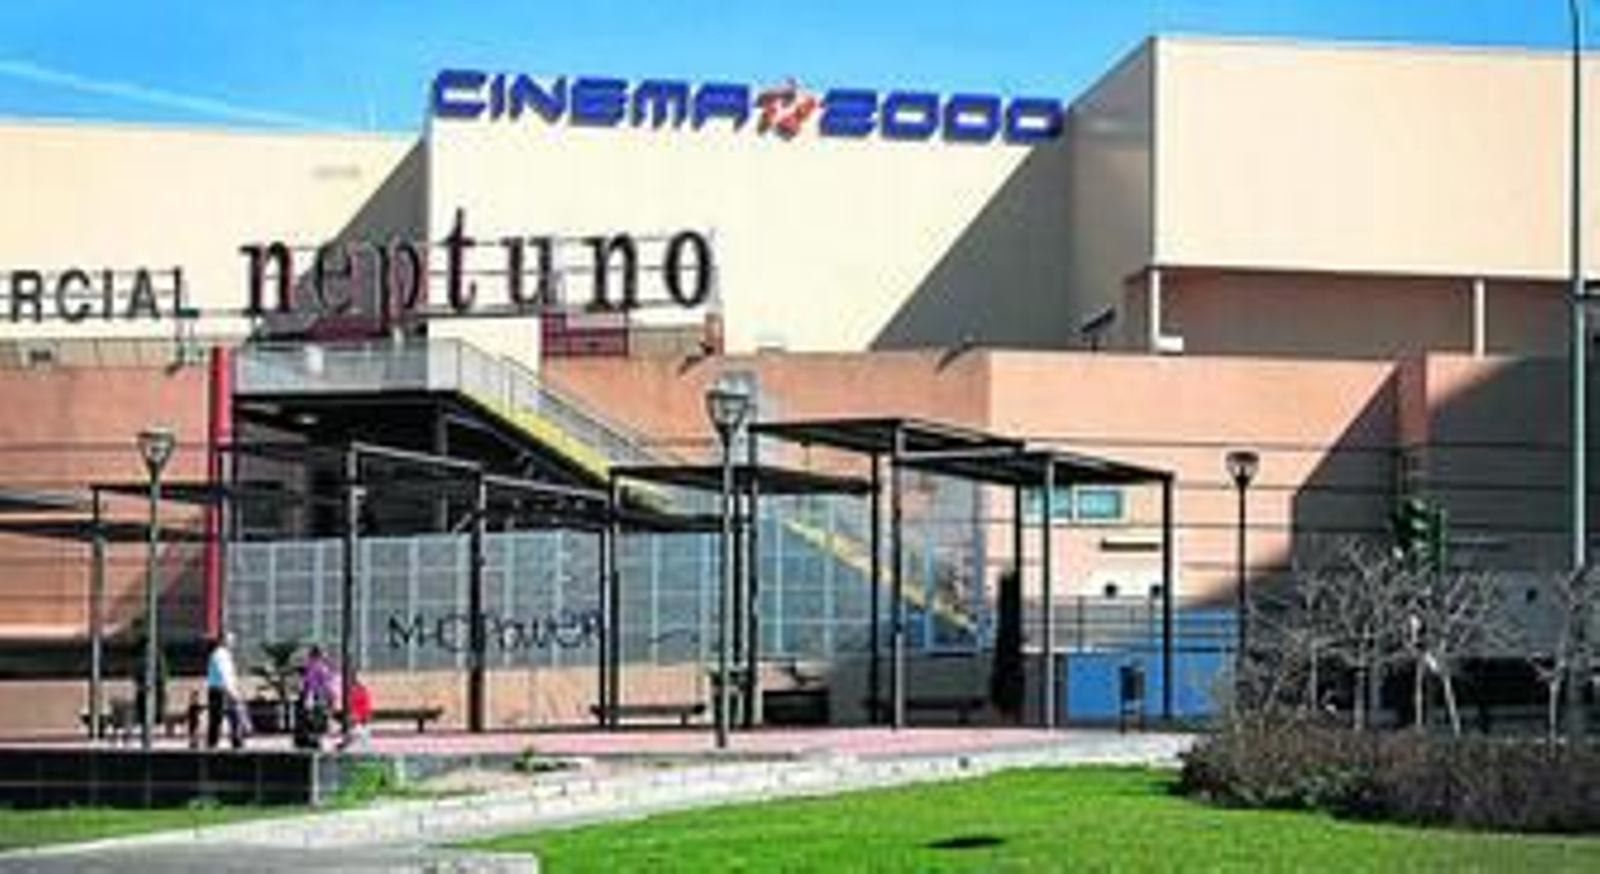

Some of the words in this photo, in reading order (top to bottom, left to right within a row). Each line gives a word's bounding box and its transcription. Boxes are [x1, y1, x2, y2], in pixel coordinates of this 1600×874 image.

[430, 69, 751, 131] CINEMA
[820, 88, 1064, 144] 2000
[240, 208, 712, 335] neptuno
